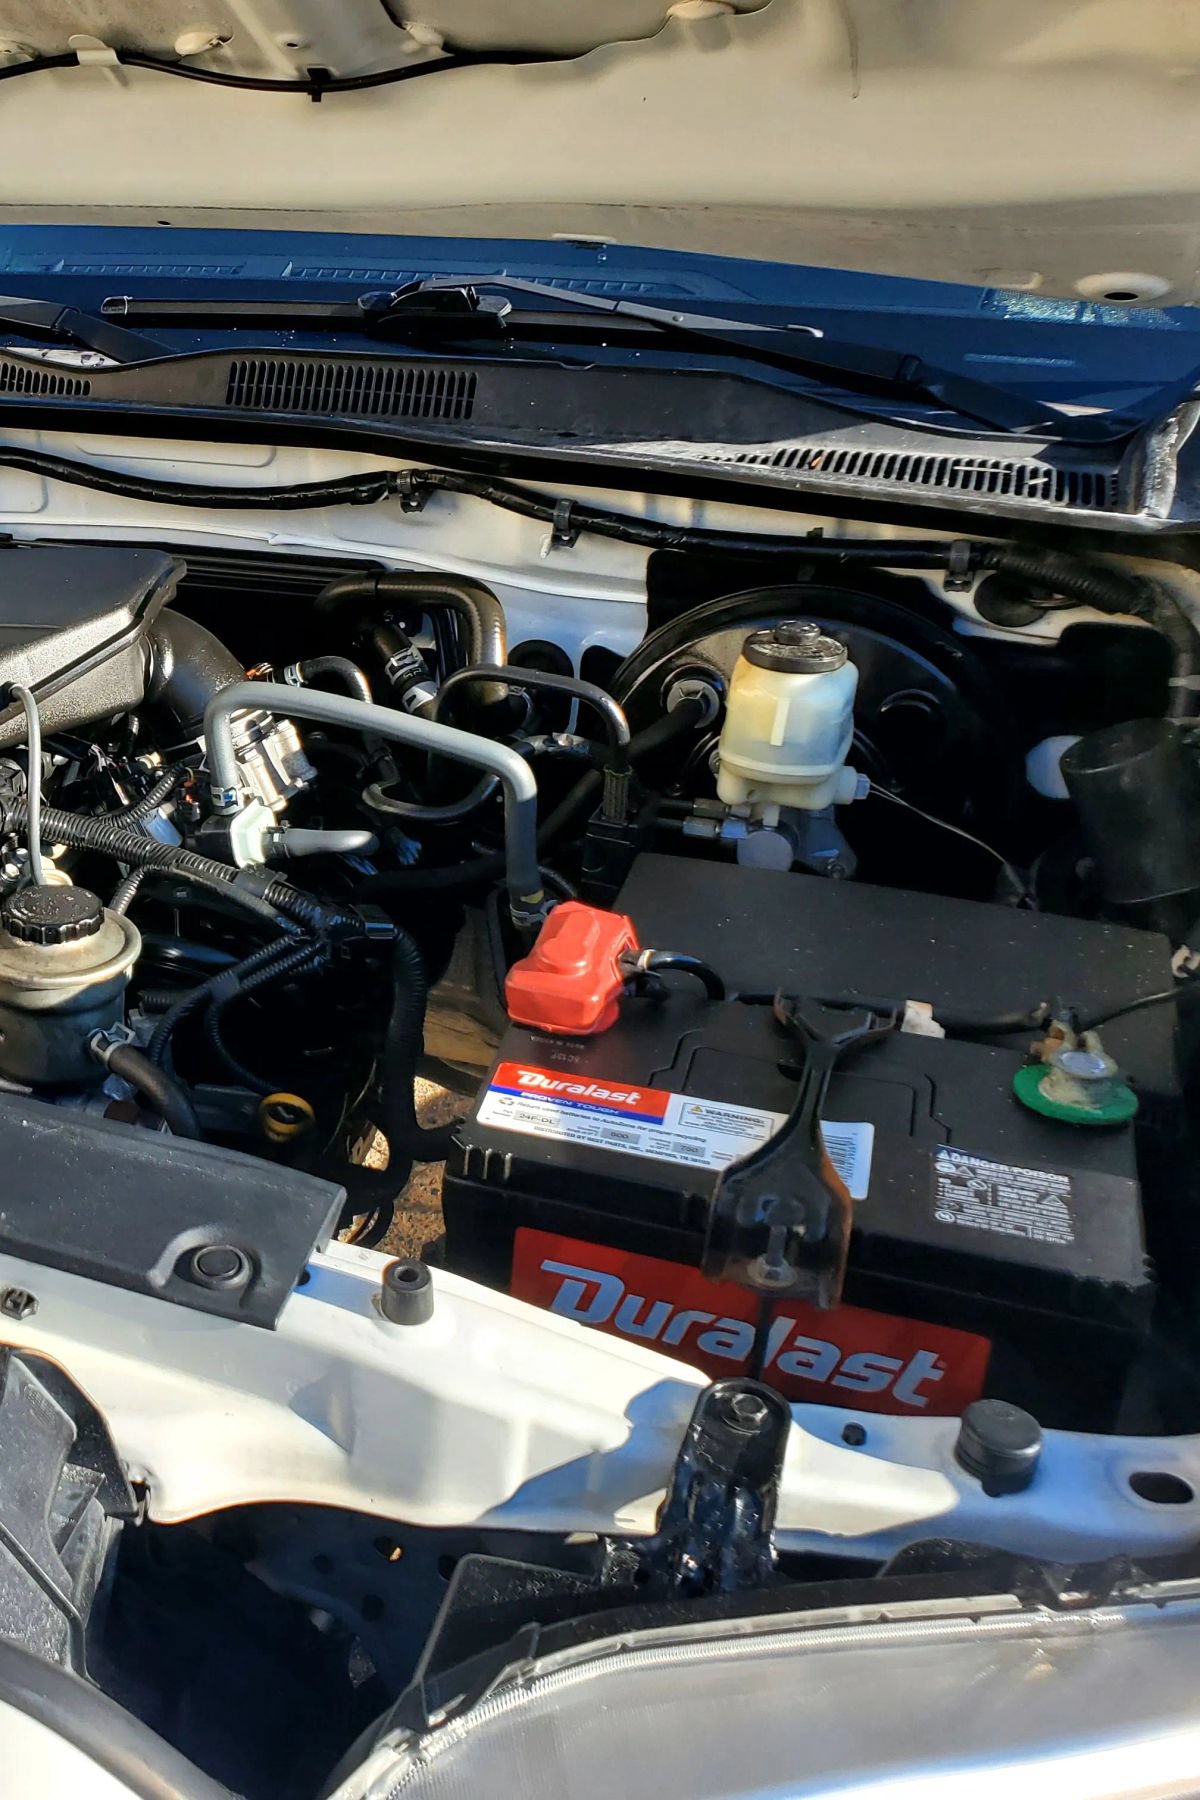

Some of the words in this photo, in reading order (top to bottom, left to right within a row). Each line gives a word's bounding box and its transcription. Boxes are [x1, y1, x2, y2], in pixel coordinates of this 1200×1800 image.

[517, 1070, 641, 1105] Duralast
[520, 1092, 573, 1106] PROVEN
[576, 1102, 620, 1115] TOUGH
[517, 1101, 540, 1110] Return
[559, 1109, 591, 1120] batteries
[600, 1117, 635, 1129] AutoZone
[648, 1127, 673, 1137] proper
[673, 1131, 707, 1143] recycling
[519, 1112, 556, 1125] 24F-DL
[539, 1259, 944, 1407] Duralast
